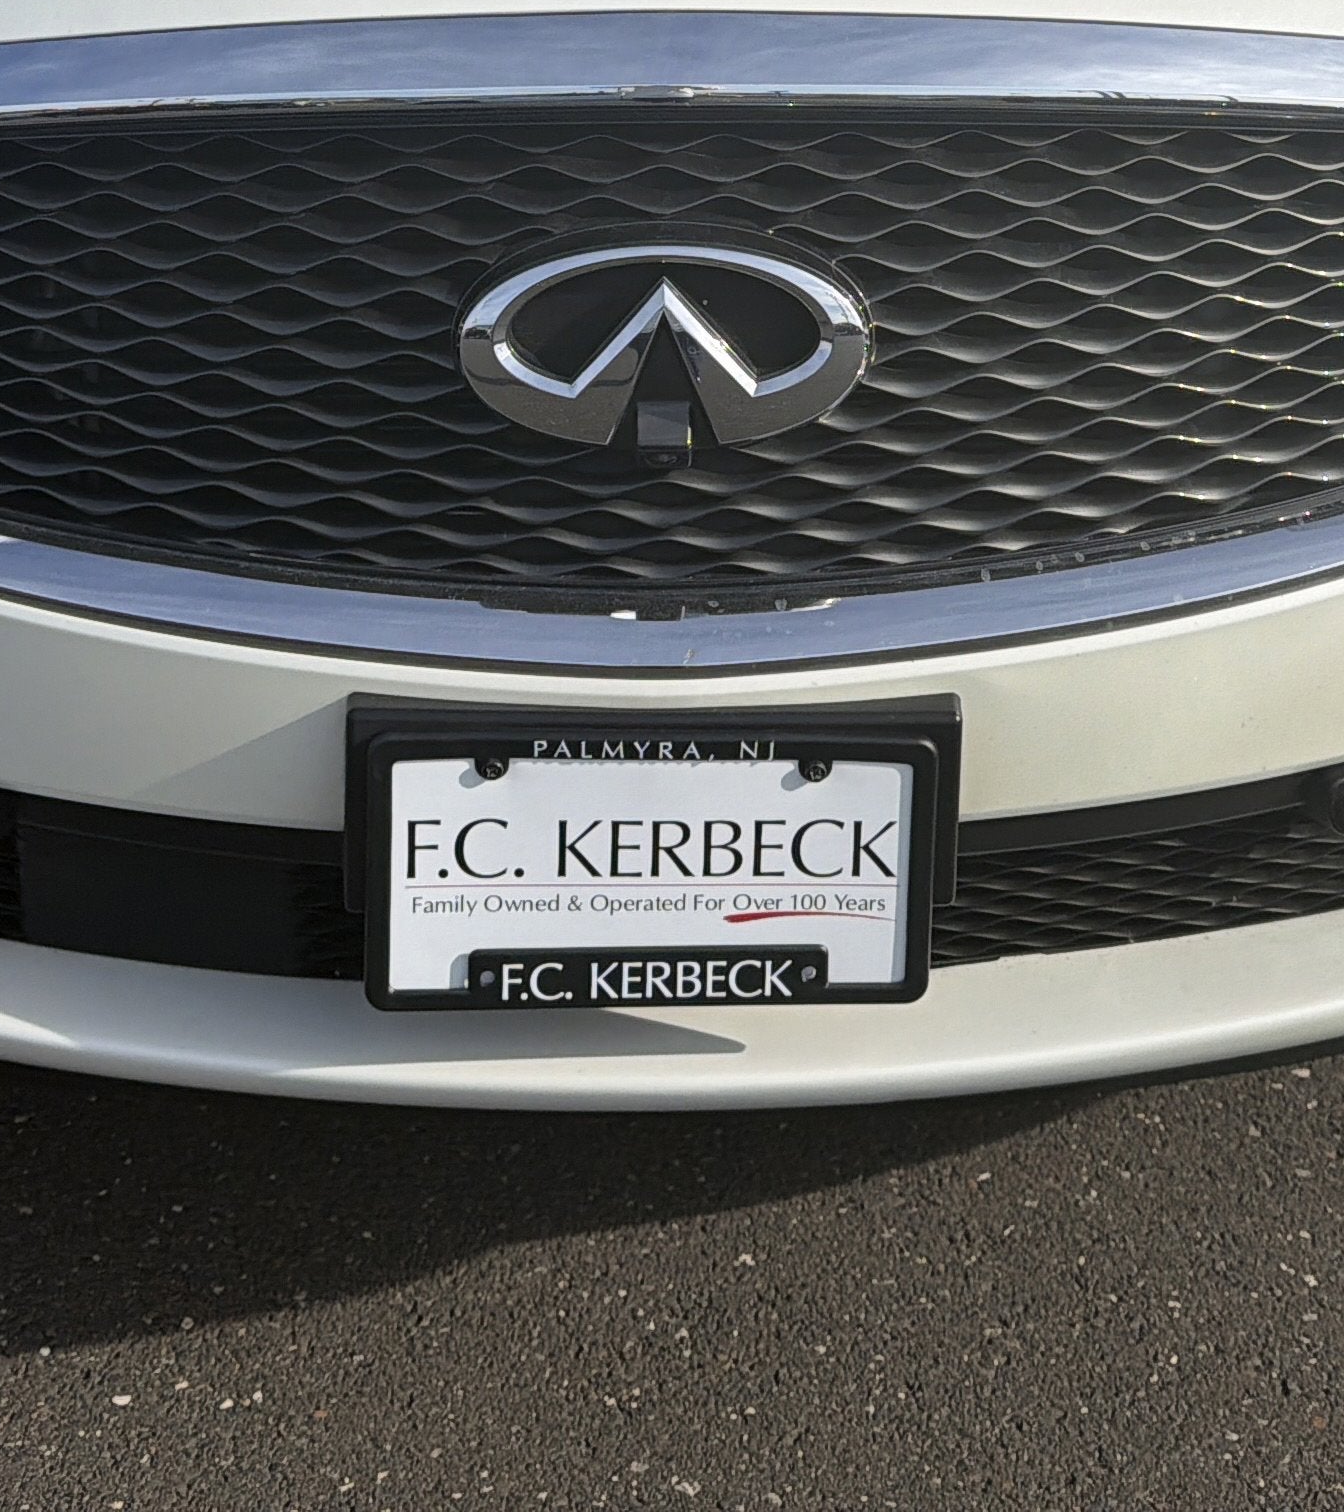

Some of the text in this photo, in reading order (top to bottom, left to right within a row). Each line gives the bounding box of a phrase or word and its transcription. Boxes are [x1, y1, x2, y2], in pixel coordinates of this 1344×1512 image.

[533, 739, 775, 762] PALMYRA, NJ
[405, 819, 898, 879] F.C. KERBECK
[412, 893, 886, 917] Family Owned & Operated For Over 100 Years
[501, 959, 793, 1001] F.C. KERBECK
